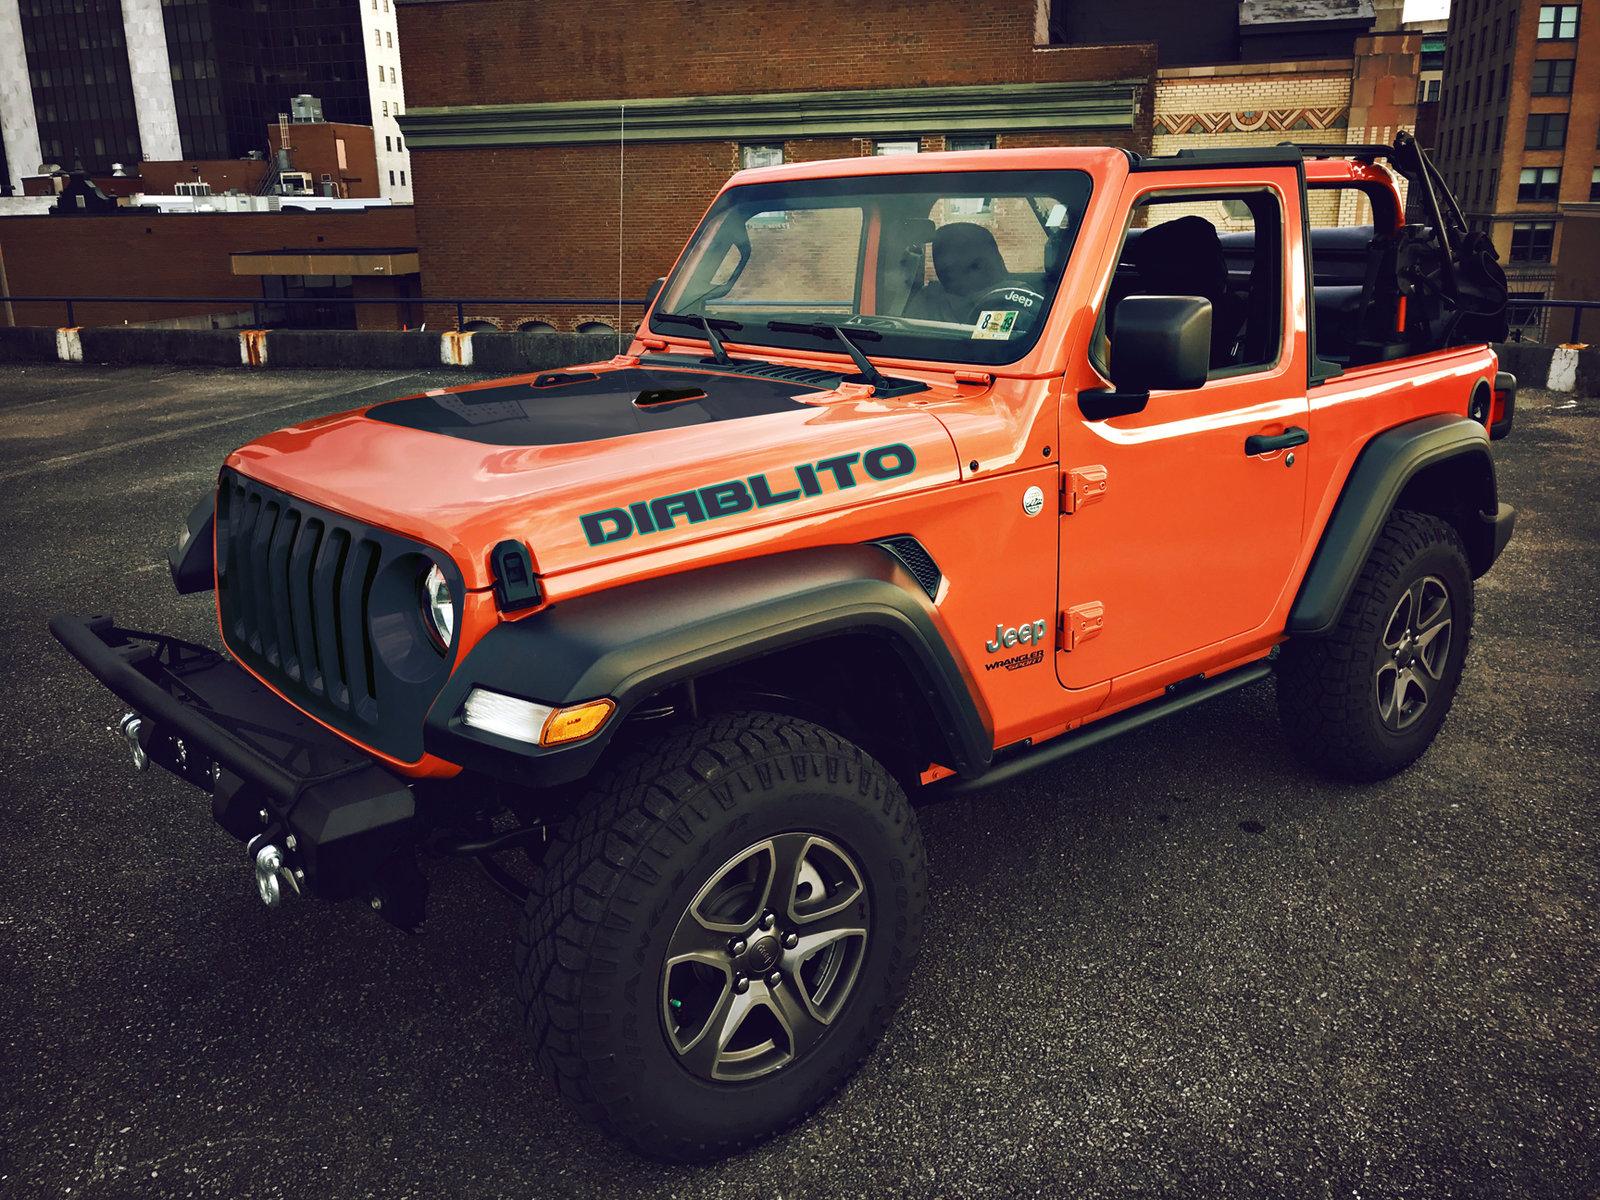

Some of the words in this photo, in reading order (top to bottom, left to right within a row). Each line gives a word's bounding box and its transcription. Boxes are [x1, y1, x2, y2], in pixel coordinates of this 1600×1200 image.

[1004, 291, 1033, 307] Jeep
[981, 313, 992, 329] 8
[579, 442, 917, 547] DIABLITO
[986, 619, 1046, 653] Jeep
[985, 650, 1044, 671] WRANGLER
